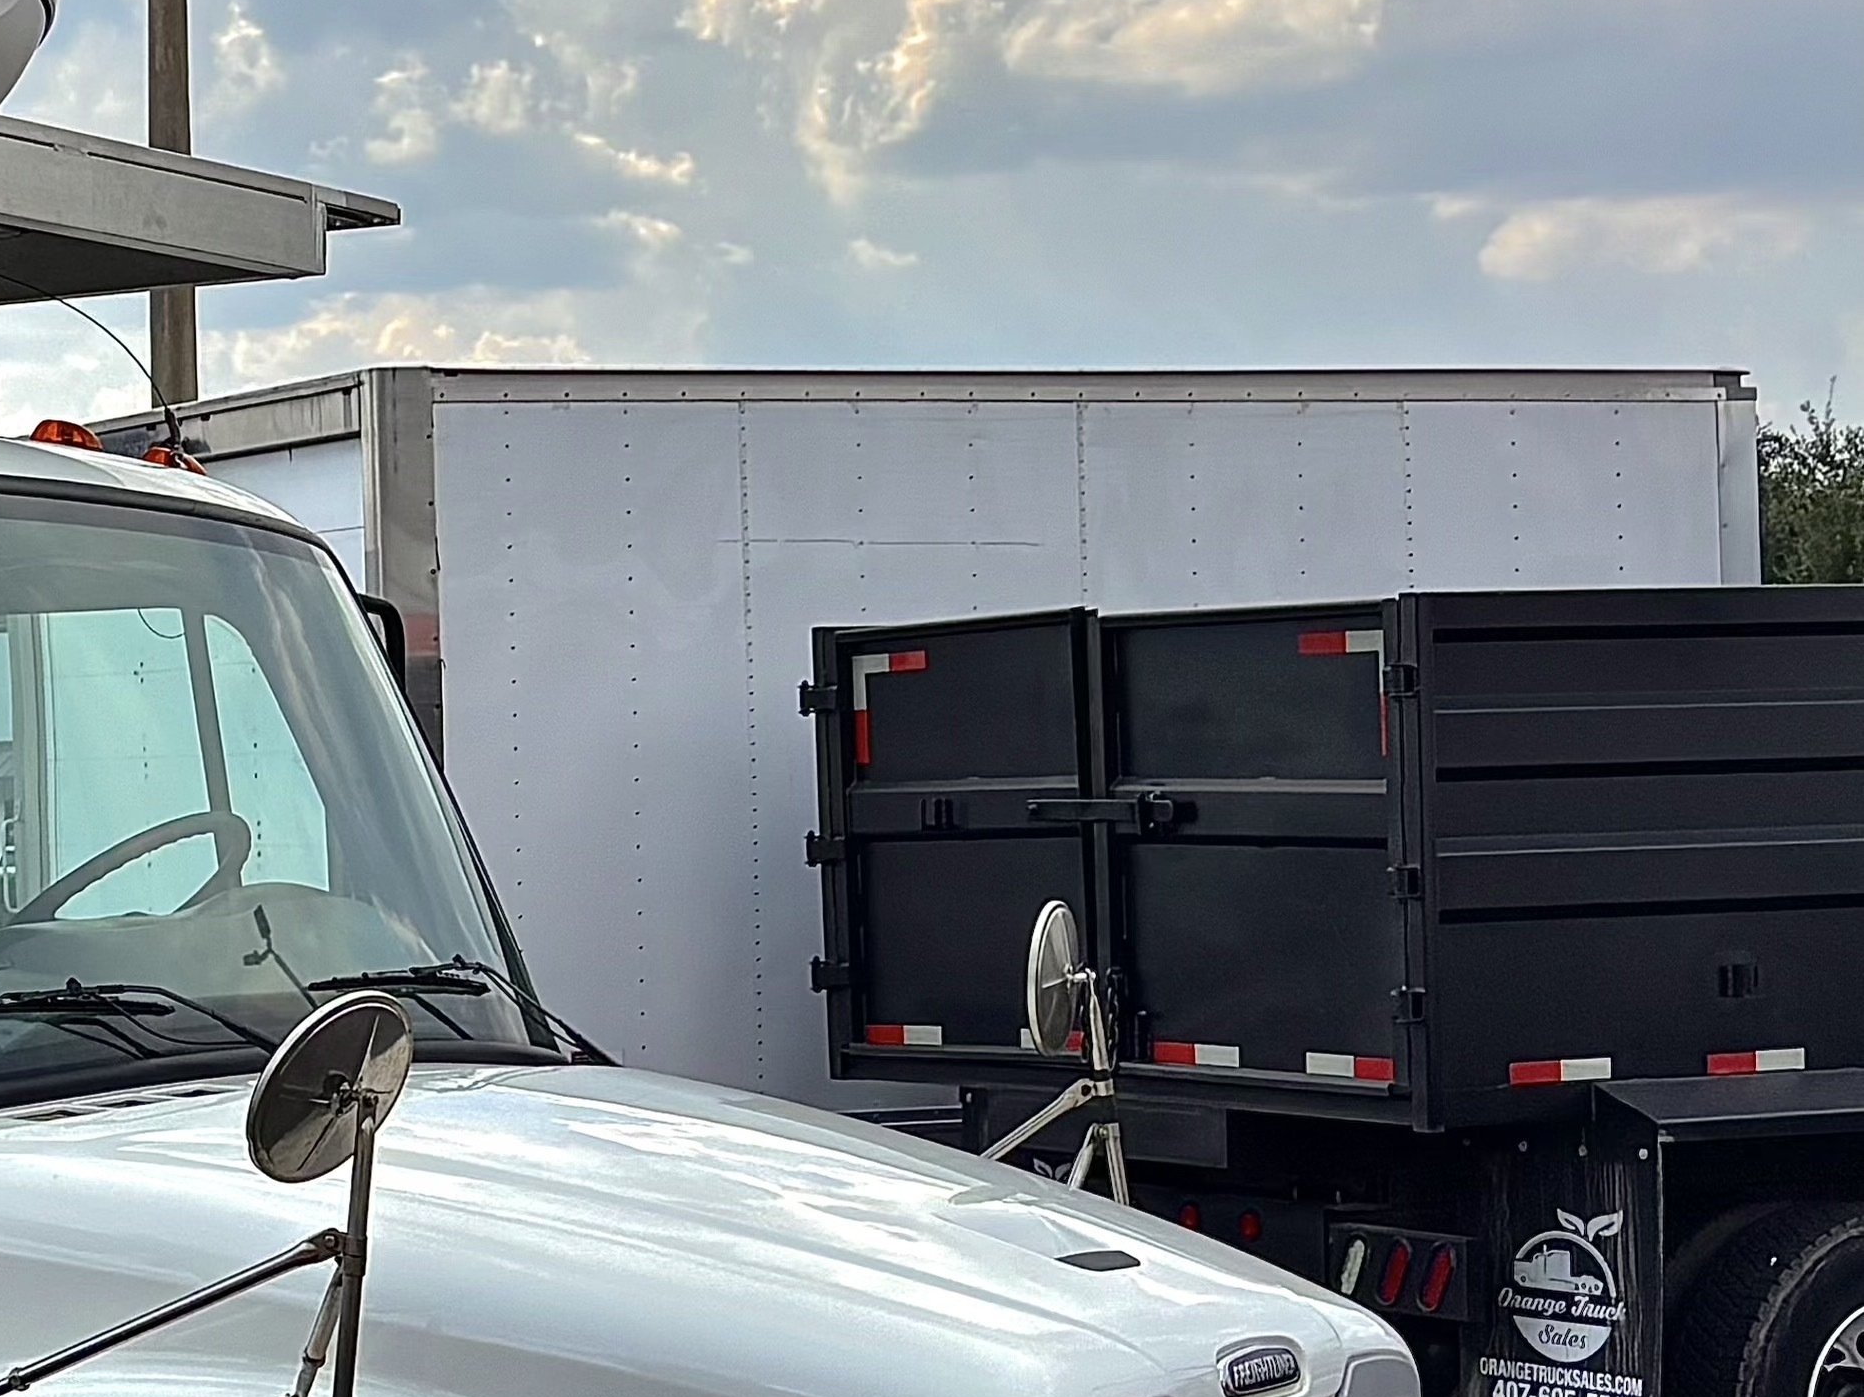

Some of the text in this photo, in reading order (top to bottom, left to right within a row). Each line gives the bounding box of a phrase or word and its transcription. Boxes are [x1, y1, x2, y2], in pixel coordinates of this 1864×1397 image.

[1498, 1287, 1627, 1321] Orange Truck
[1538, 1324, 1587, 1350] Sales
[1479, 1357, 1643, 1397] ORANGETRUCKSALES.COM
